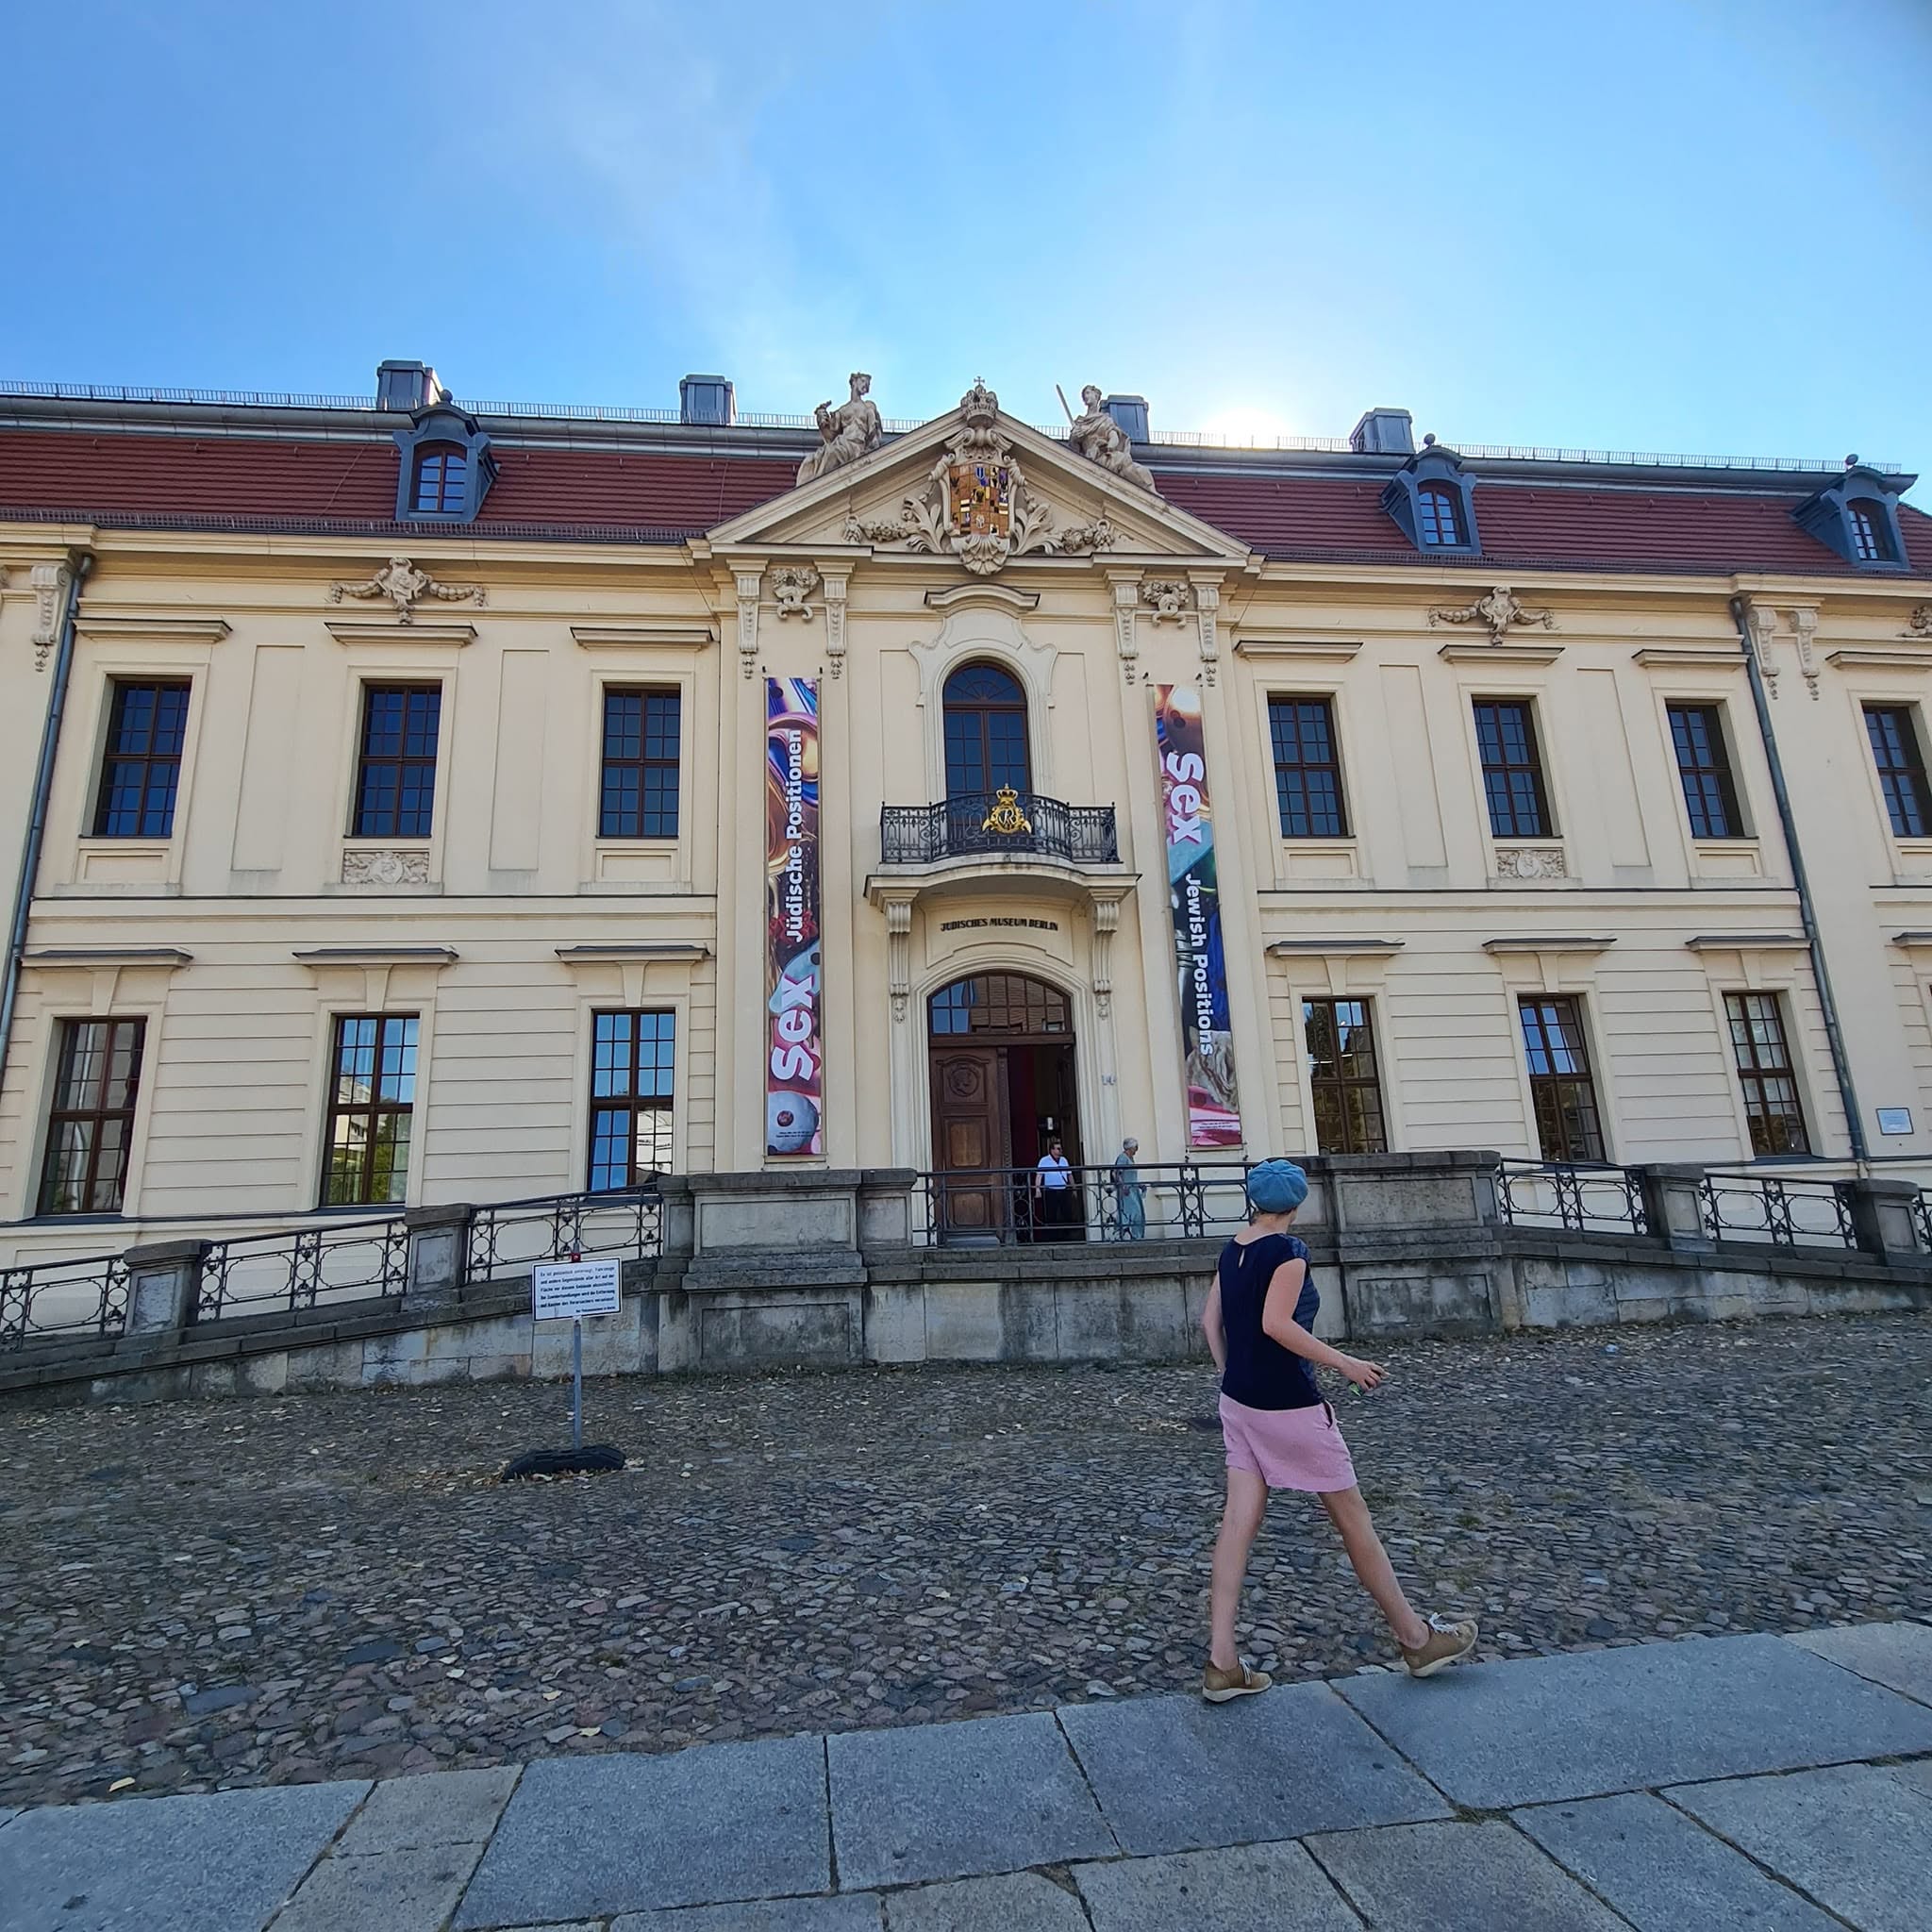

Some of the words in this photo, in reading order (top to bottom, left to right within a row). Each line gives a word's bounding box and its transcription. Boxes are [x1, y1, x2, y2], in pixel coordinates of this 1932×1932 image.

[785, 730, 803, 840] Positionen
[1166, 752, 1205, 844] Sex
[785, 846, 803, 942] Jüdische
[990, 918, 1028, 926] MUSEUM
[1028, 919, 1058, 931] BERLIN
[1185, 874, 1208, 947] Jewish
[771, 974, 814, 1080] Sex
[1192, 954, 1215, 1057] Positions
